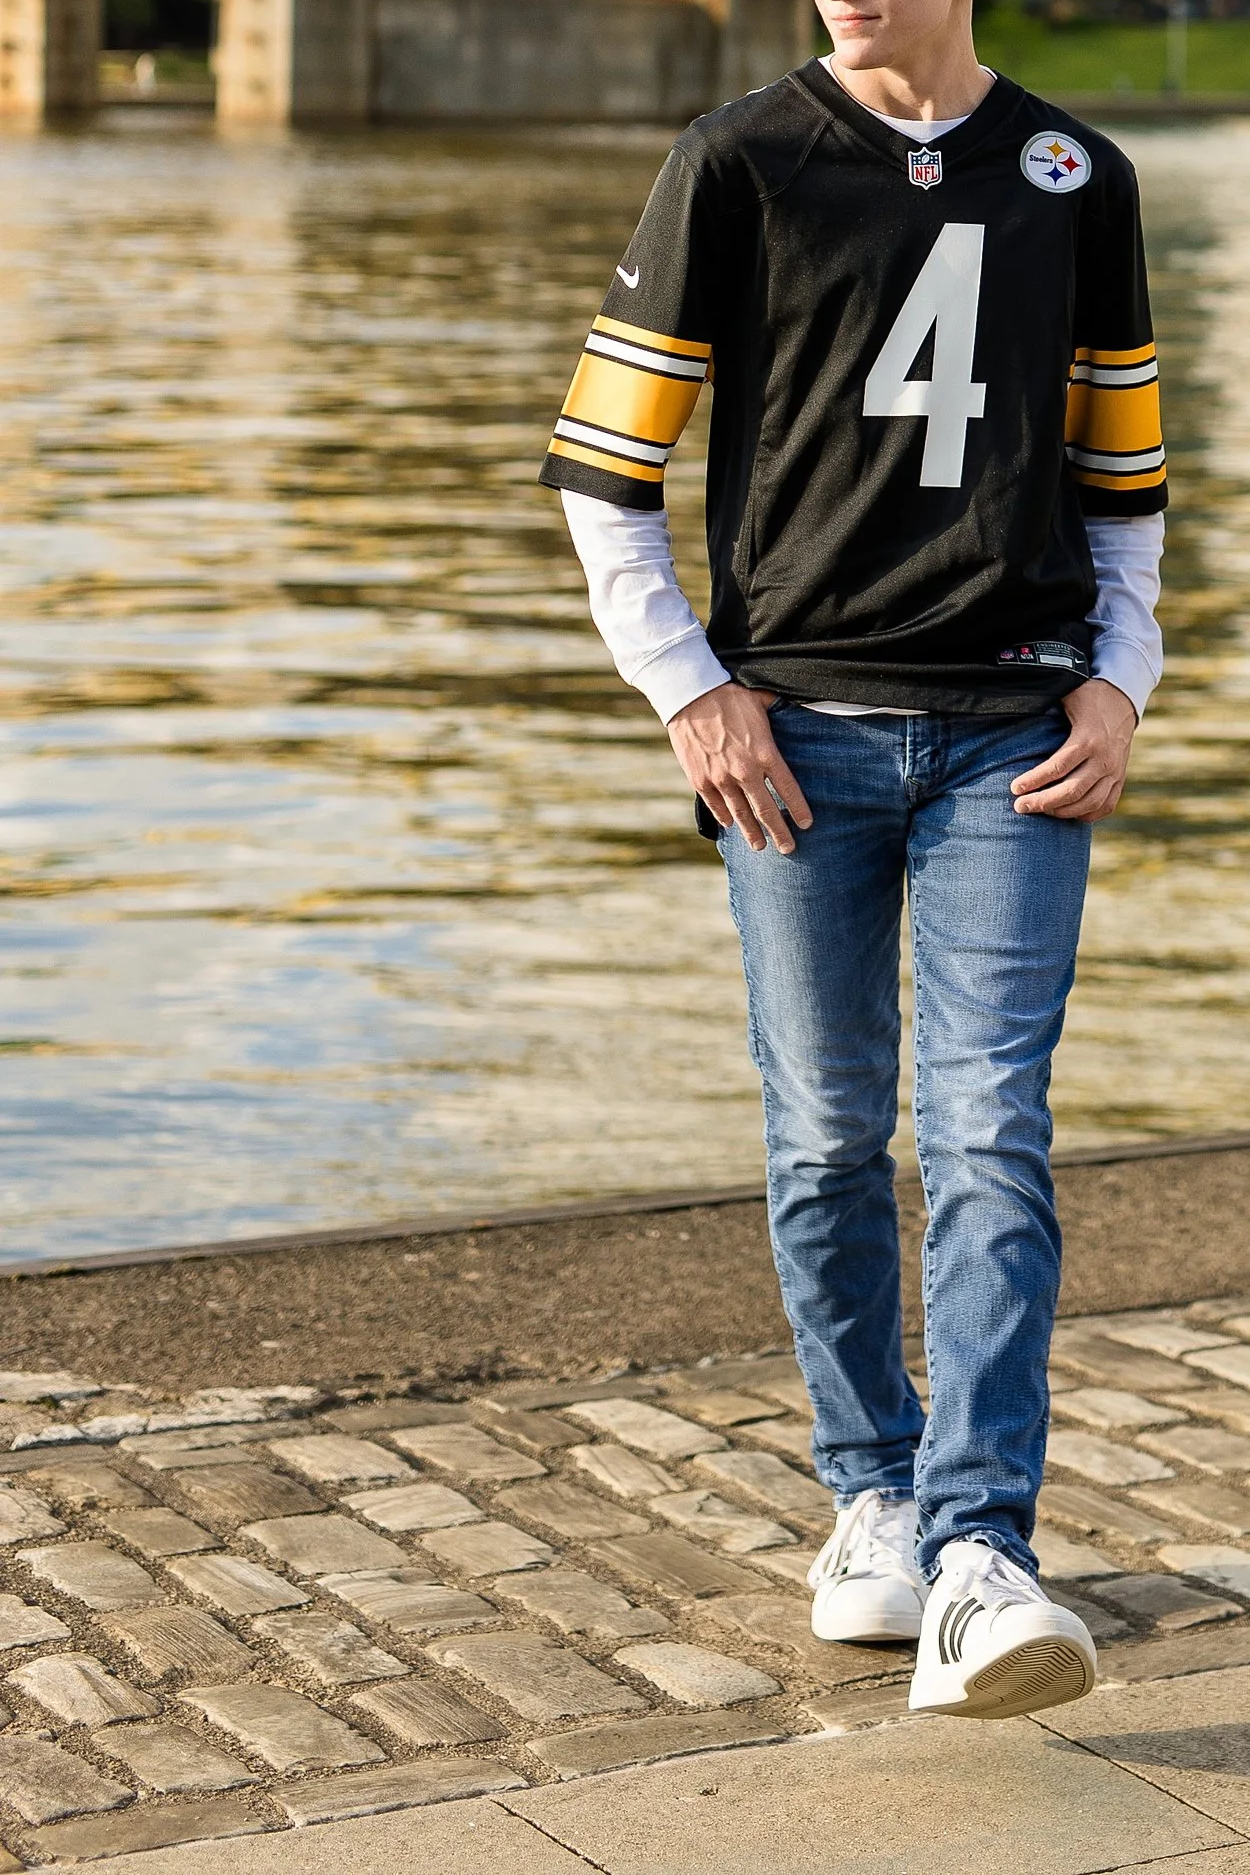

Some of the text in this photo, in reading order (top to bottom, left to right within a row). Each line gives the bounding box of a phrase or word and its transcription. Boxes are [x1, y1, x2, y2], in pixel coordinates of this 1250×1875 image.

[1029, 154, 1053, 164] Steelers
[915, 166, 938, 182] NFL
[862, 222, 986, 488] 4
